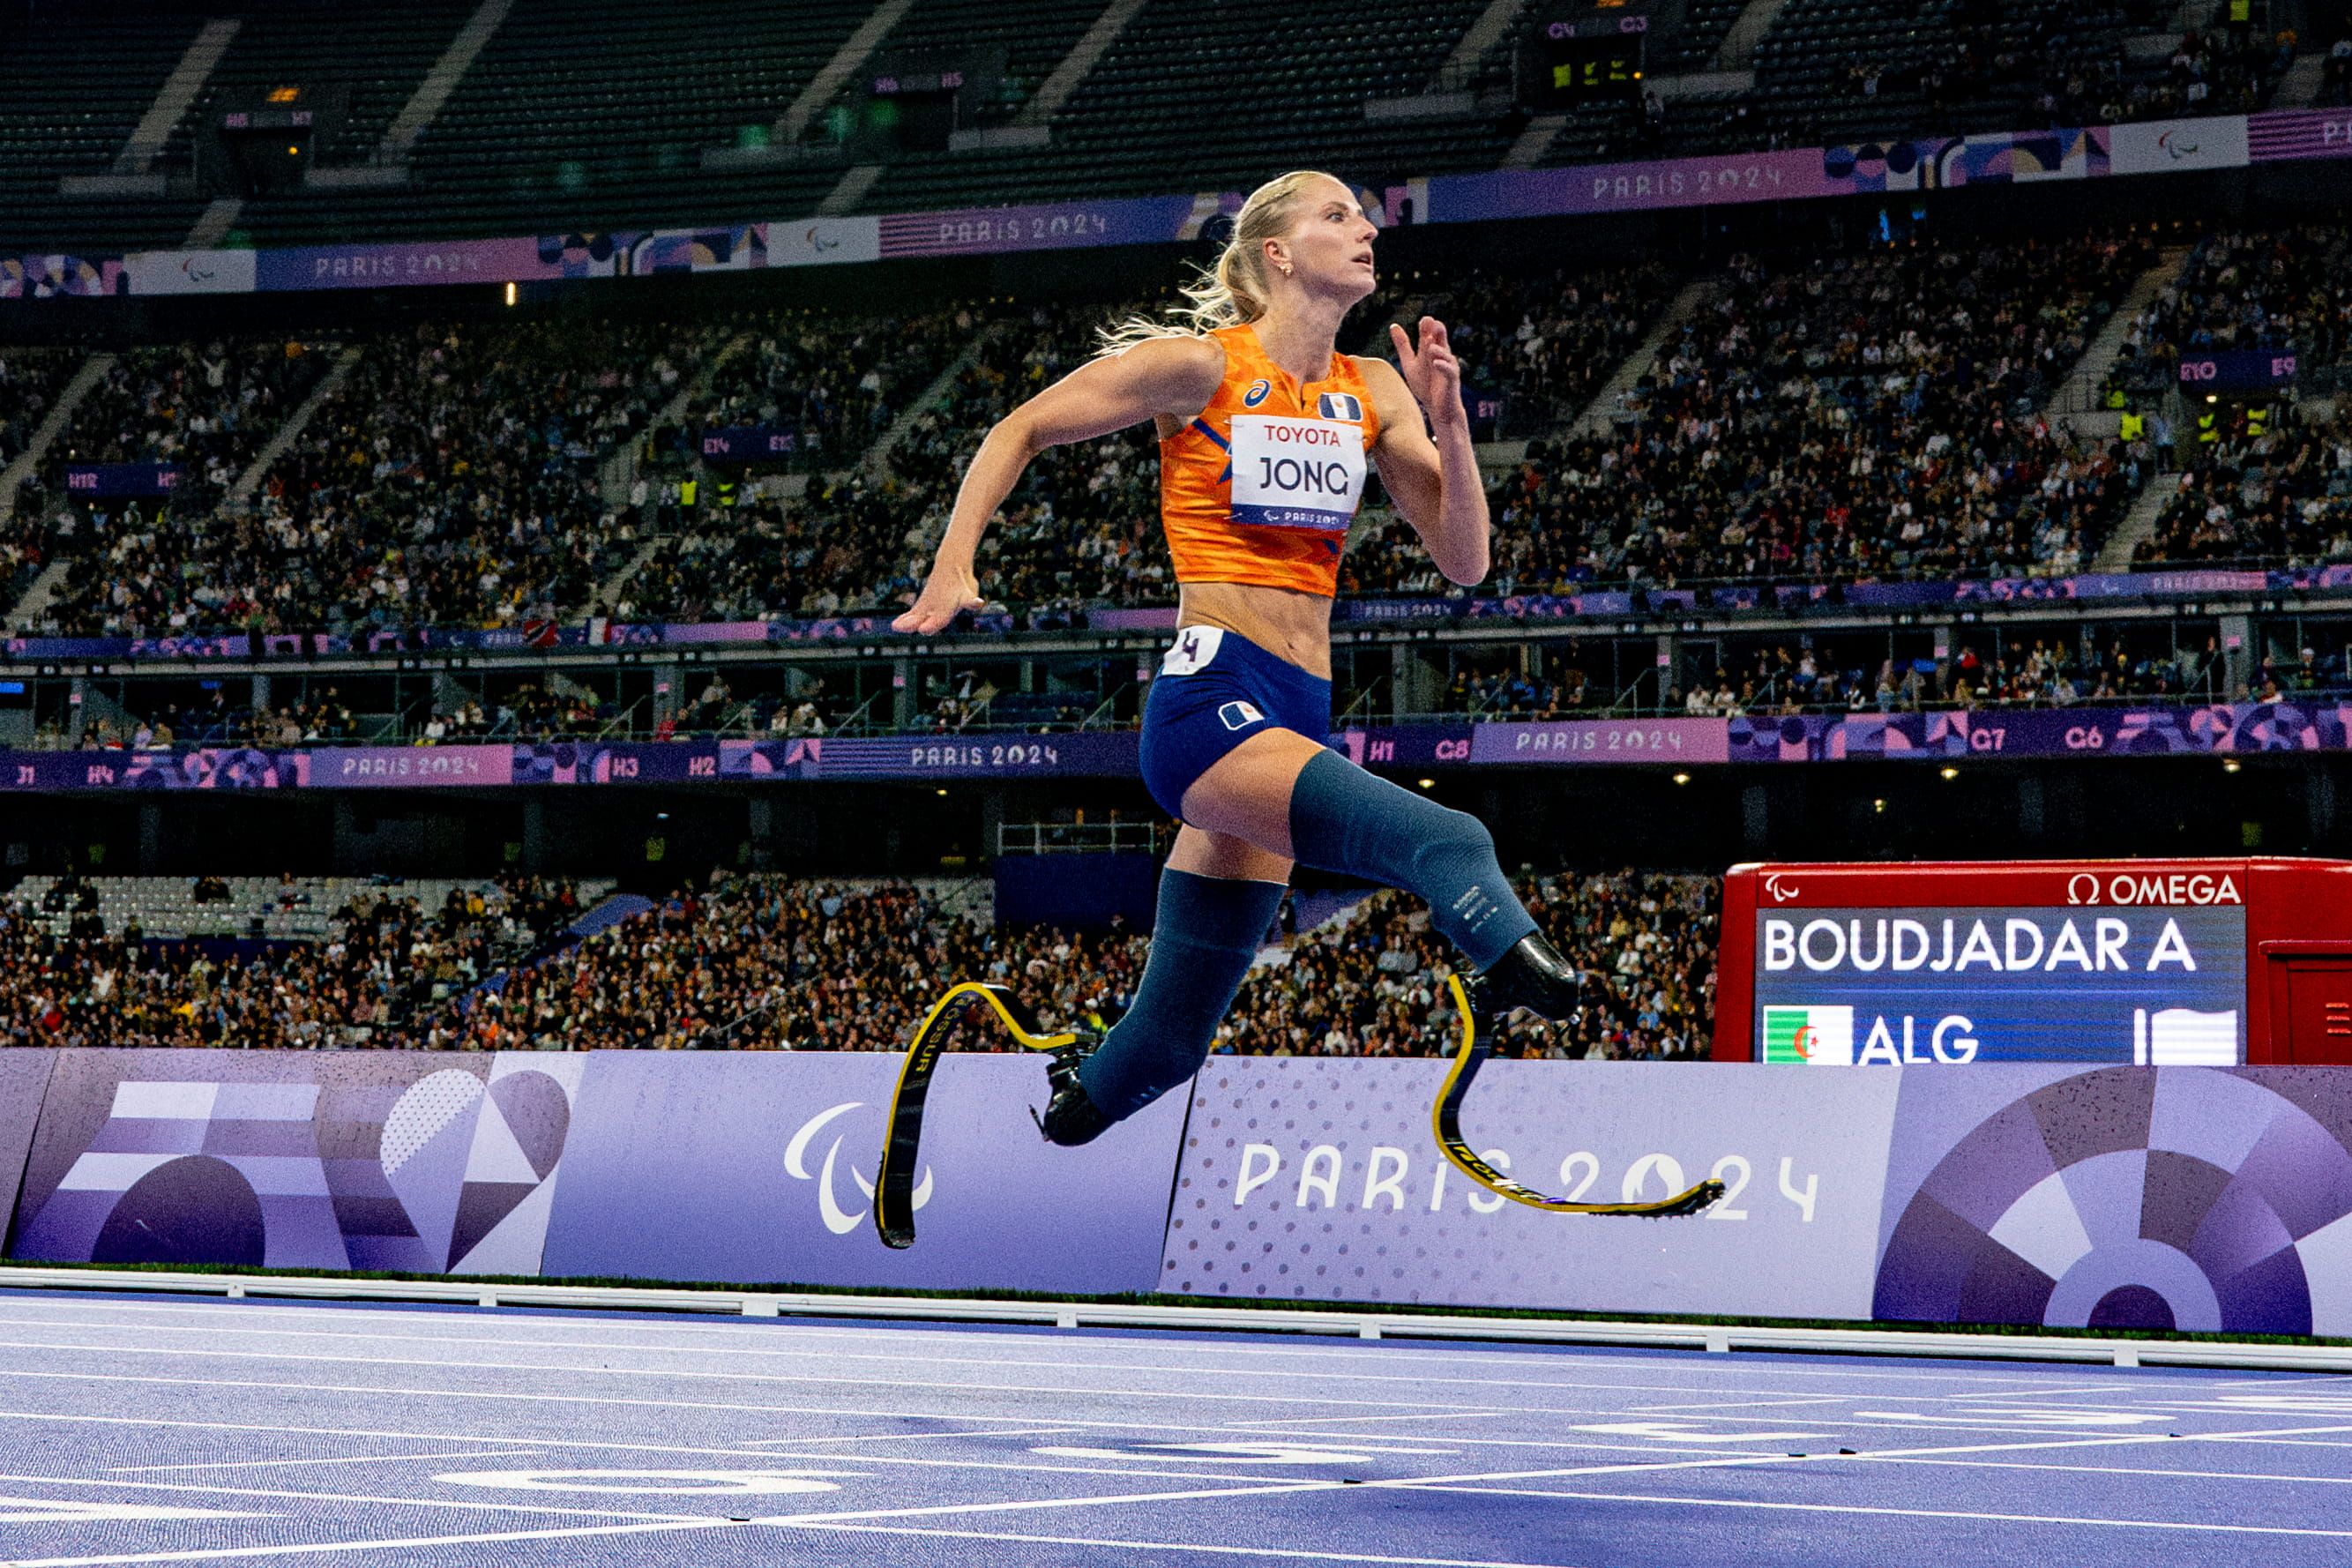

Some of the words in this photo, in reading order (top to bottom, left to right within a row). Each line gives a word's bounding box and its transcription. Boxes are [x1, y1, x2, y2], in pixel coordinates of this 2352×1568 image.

[1594, 172, 1684, 200] PARIS
[1698, 165, 1781, 192] 2024
[939, 219, 1019, 242] PARIS
[1032, 213, 1106, 238] 2024
[316, 256, 395, 279] PARIS
[1264, 425, 1340, 447] TOYOTA
[1260, 457, 1348, 496] JONG
[1316, 515, 1340, 525] 202
[1182, 631, 1199, 662] 4
[1369, 741, 1393, 762] H1
[1516, 731, 1595, 750] PARIS
[1608, 730, 1681, 750] 2024
[342, 757, 410, 775] PARIS
[418, 756, 479, 775] 2024
[613, 757, 639, 776] H3
[689, 756, 715, 776] H2
[912, 745, 983, 766] PARIS
[992, 744, 1057, 765] 2024
[2109, 874, 2242, 904] OMEGA
[1765, 917, 2130, 971] BOUDJADAR
[2147, 917, 2197, 971] A
[1857, 1015, 1979, 1066] ALG
[1234, 1143, 1511, 1214] PARIS
[1558, 1151, 1819, 1222] 2024
